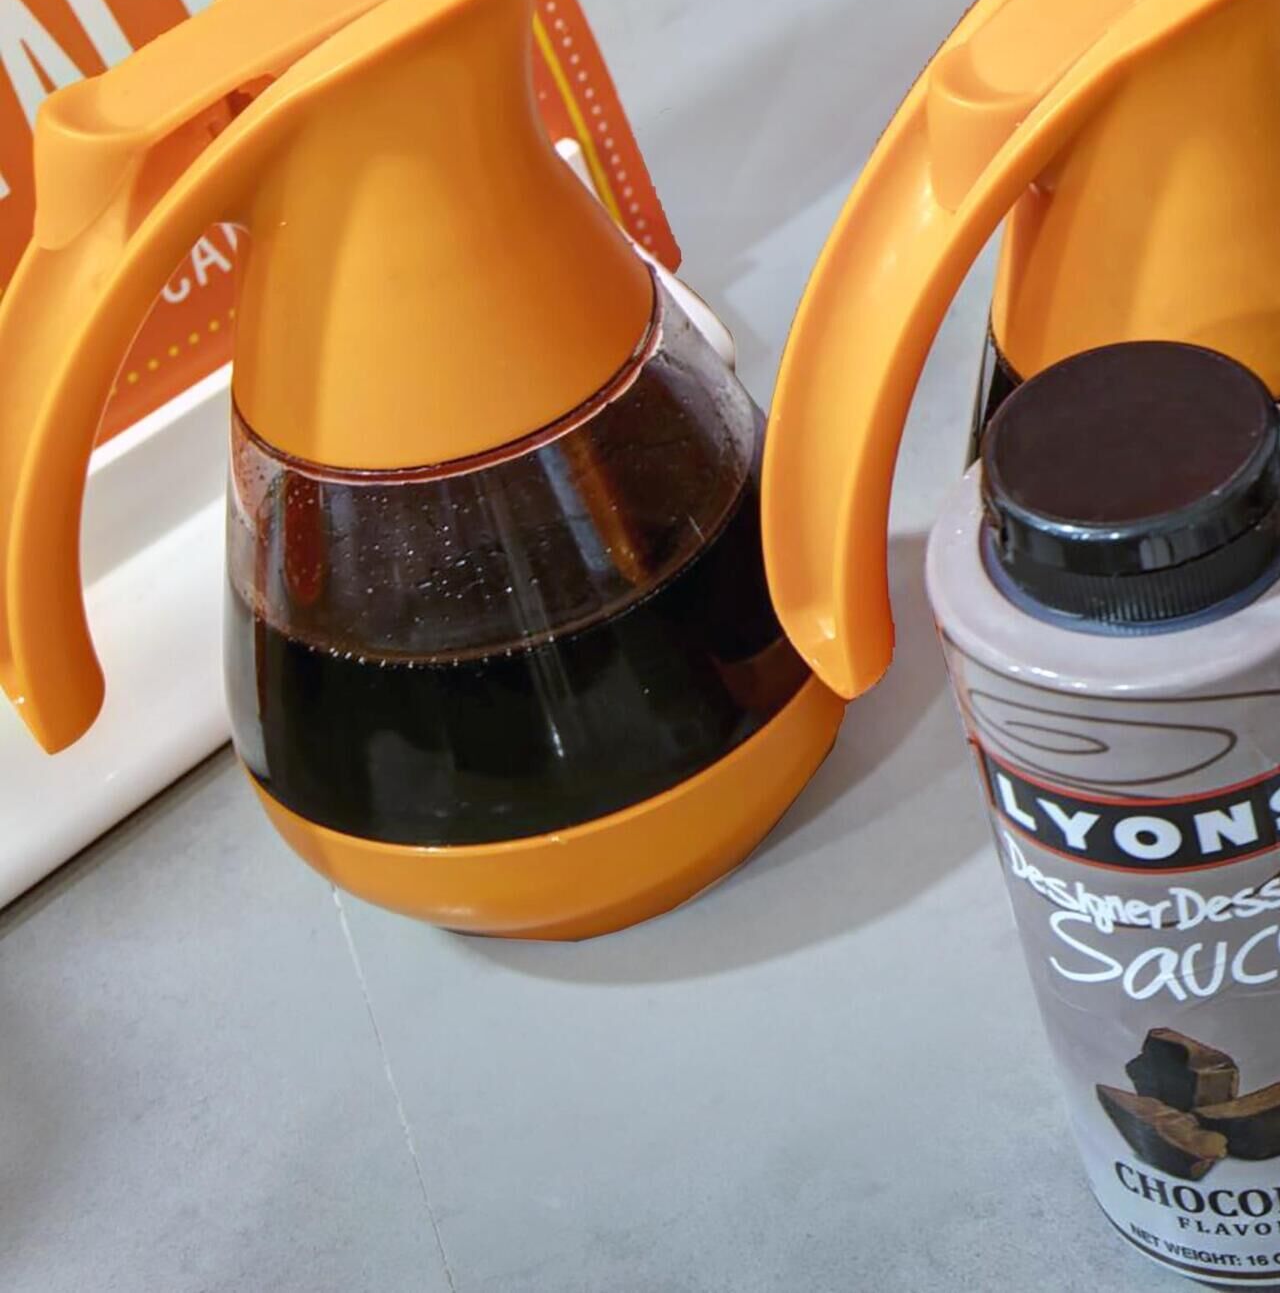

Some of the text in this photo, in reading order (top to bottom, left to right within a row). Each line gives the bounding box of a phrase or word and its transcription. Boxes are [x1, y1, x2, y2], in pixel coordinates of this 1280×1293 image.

[1003, 828, 1174, 935] Designer
[1130, 1222, 1161, 1249] NET
[1163, 1241, 1243, 1267] WEIGHT:
[1247, 1254, 1270, 1267] 16
